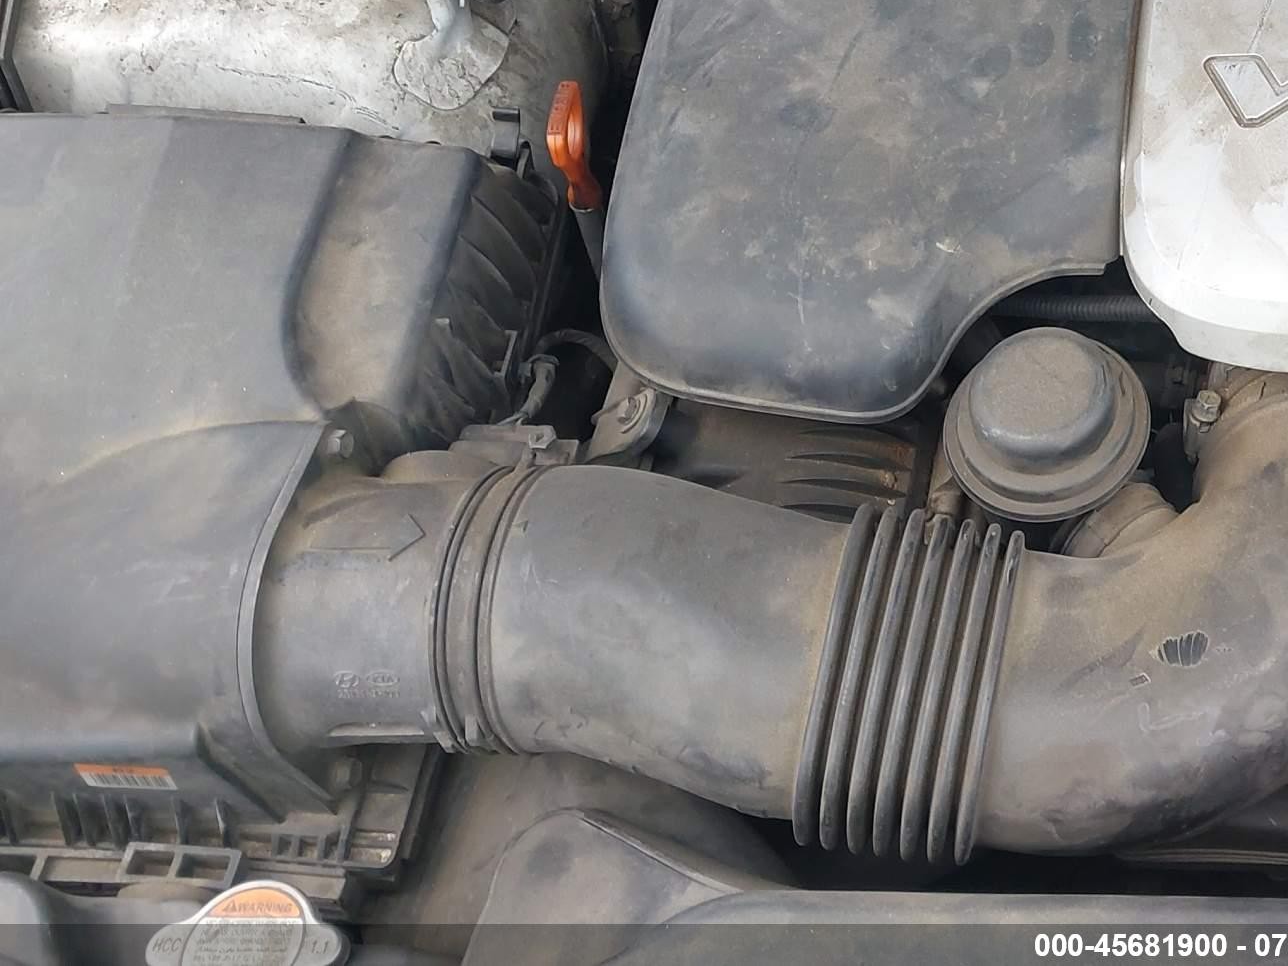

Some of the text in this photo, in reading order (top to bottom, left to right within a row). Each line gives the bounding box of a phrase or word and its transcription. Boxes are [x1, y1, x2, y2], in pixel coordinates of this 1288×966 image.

[237, 900, 293, 914] WARNING
[152, 937, 182, 953] HCC
[311, 939, 330, 954] 1.1
